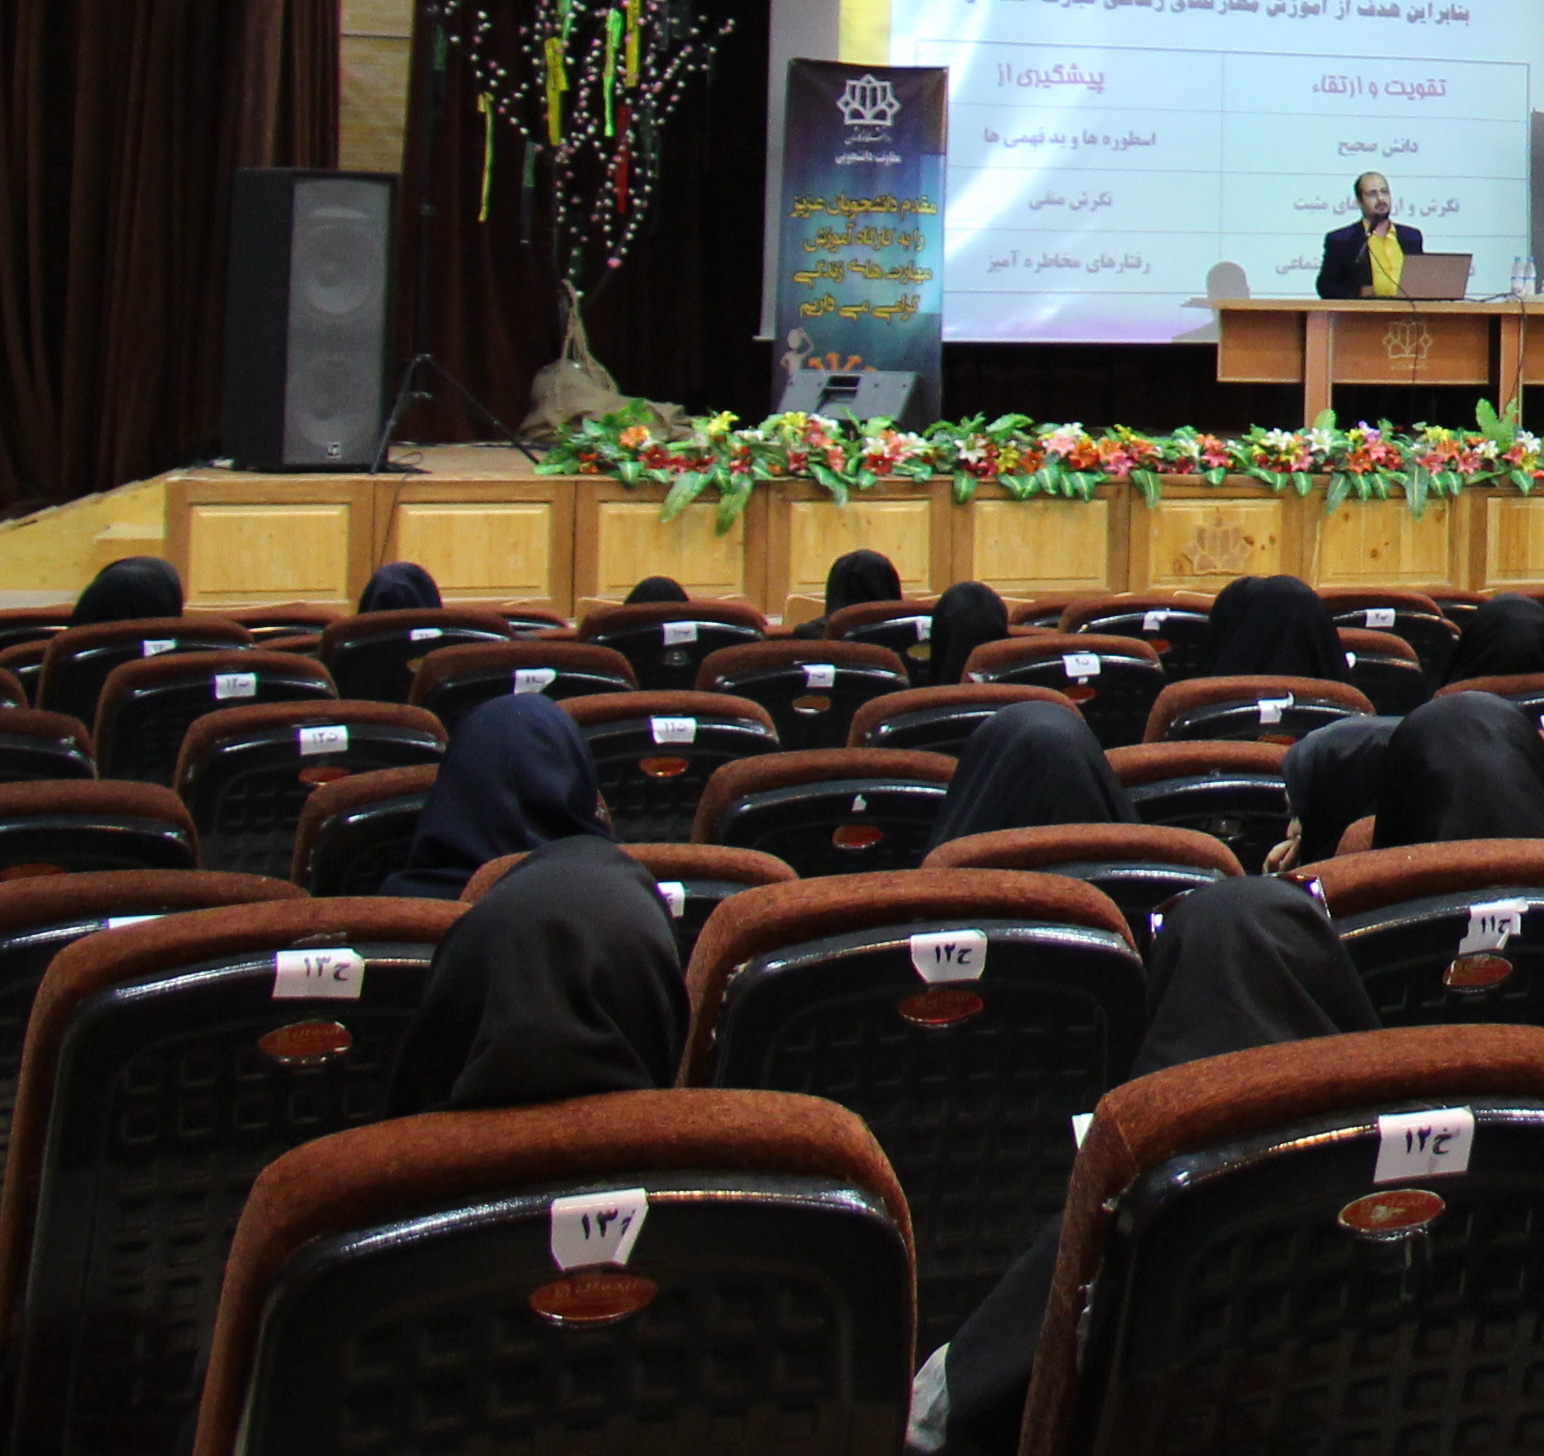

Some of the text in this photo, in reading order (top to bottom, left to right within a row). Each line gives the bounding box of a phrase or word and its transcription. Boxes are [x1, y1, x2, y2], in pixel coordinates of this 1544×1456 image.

[1357, 0, 1401, 18] هدف
[1406, 2, 1470, 27] بنابراین
[997, 62, 1105, 94] پیشگیری از
[1312, 74, 1447, 100] تقویت و ارتقاء
[983, 127, 999, 143] ها
[1004, 127, 1045, 148] فهمی
[1070, 136, 1079, 150] و
[1082, 130, 1098, 145] ها
[1101, 131, 1156, 151] اسطوره
[1337, 137, 1419, 157] دانش صحیح
[790, 192, 938, 221] مقدم دانشجویان عزیز
[1069, 191, 1113, 211] نگرش
[1407, 202, 1415, 217] و
[1420, 197, 1461, 217] نگرش
[803, 223, 925, 253] را به کارگاه آموزش
[884, 260, 933, 285] مهارت
[800, 293, 920, 325] گرامی می داریم
